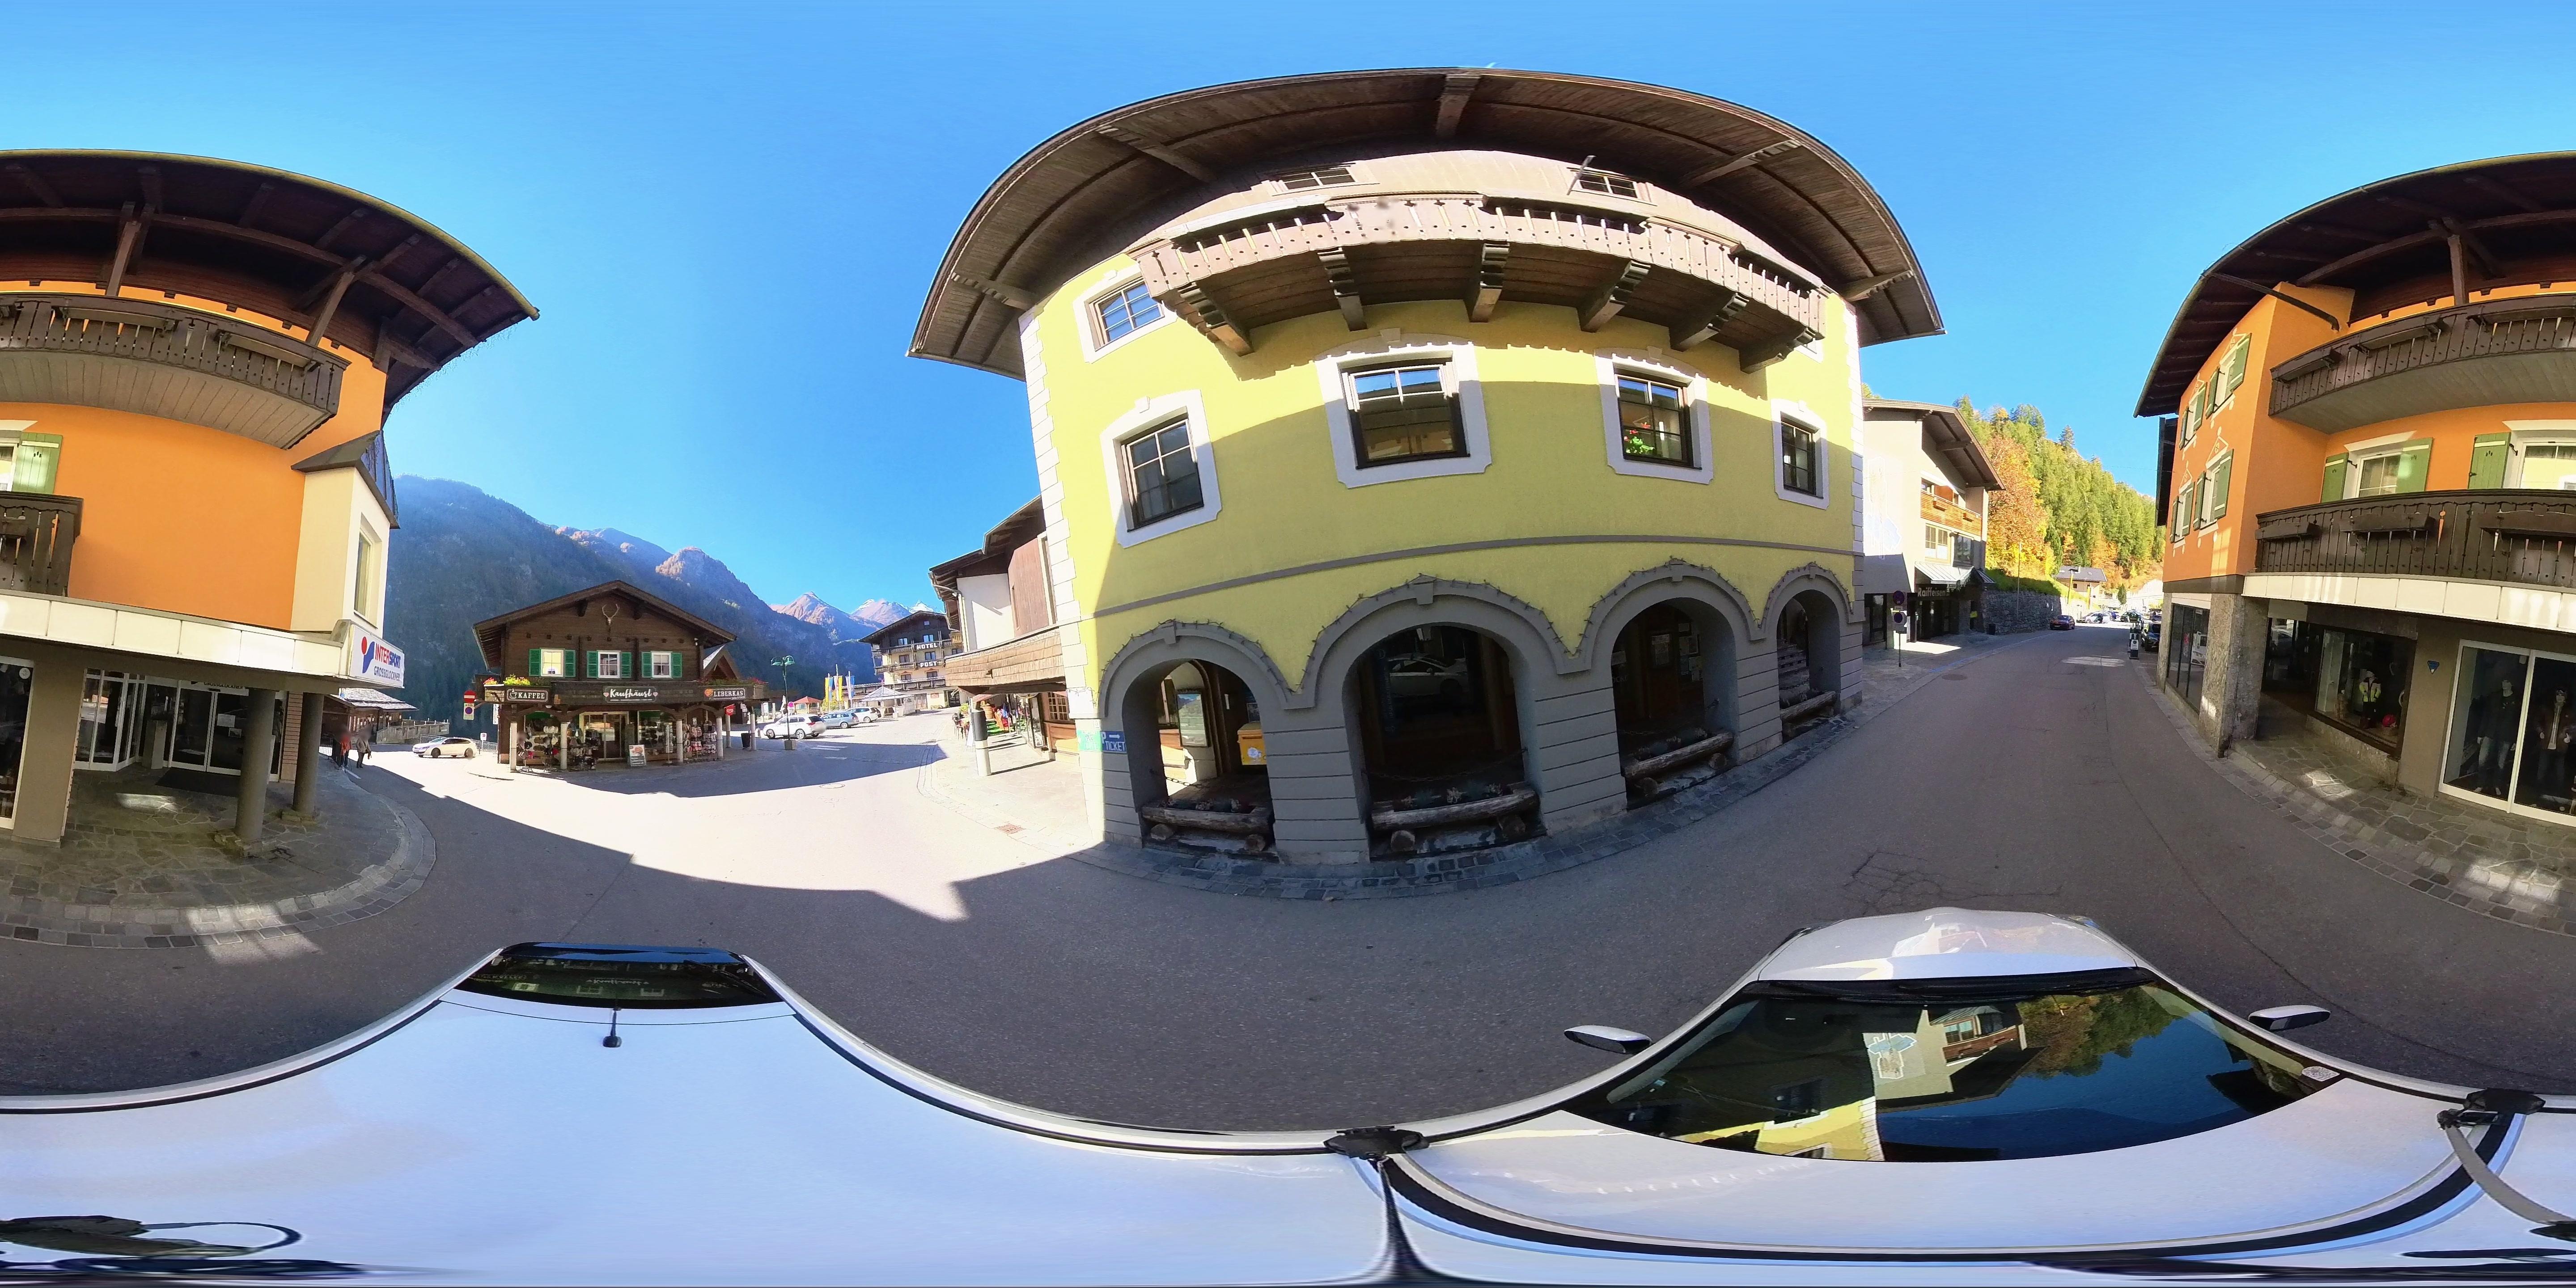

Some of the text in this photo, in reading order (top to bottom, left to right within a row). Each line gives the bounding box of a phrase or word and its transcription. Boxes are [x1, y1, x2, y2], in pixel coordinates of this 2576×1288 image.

[375, 643, 401, 669] INTERSPORT
[374, 665, 400, 681] GROSSGLOCKNER
[610, 689, 652, 698] Kaufhäusl
[1102, 731, 1106, 744] P
[1105, 741, 1125, 751] TICKET
